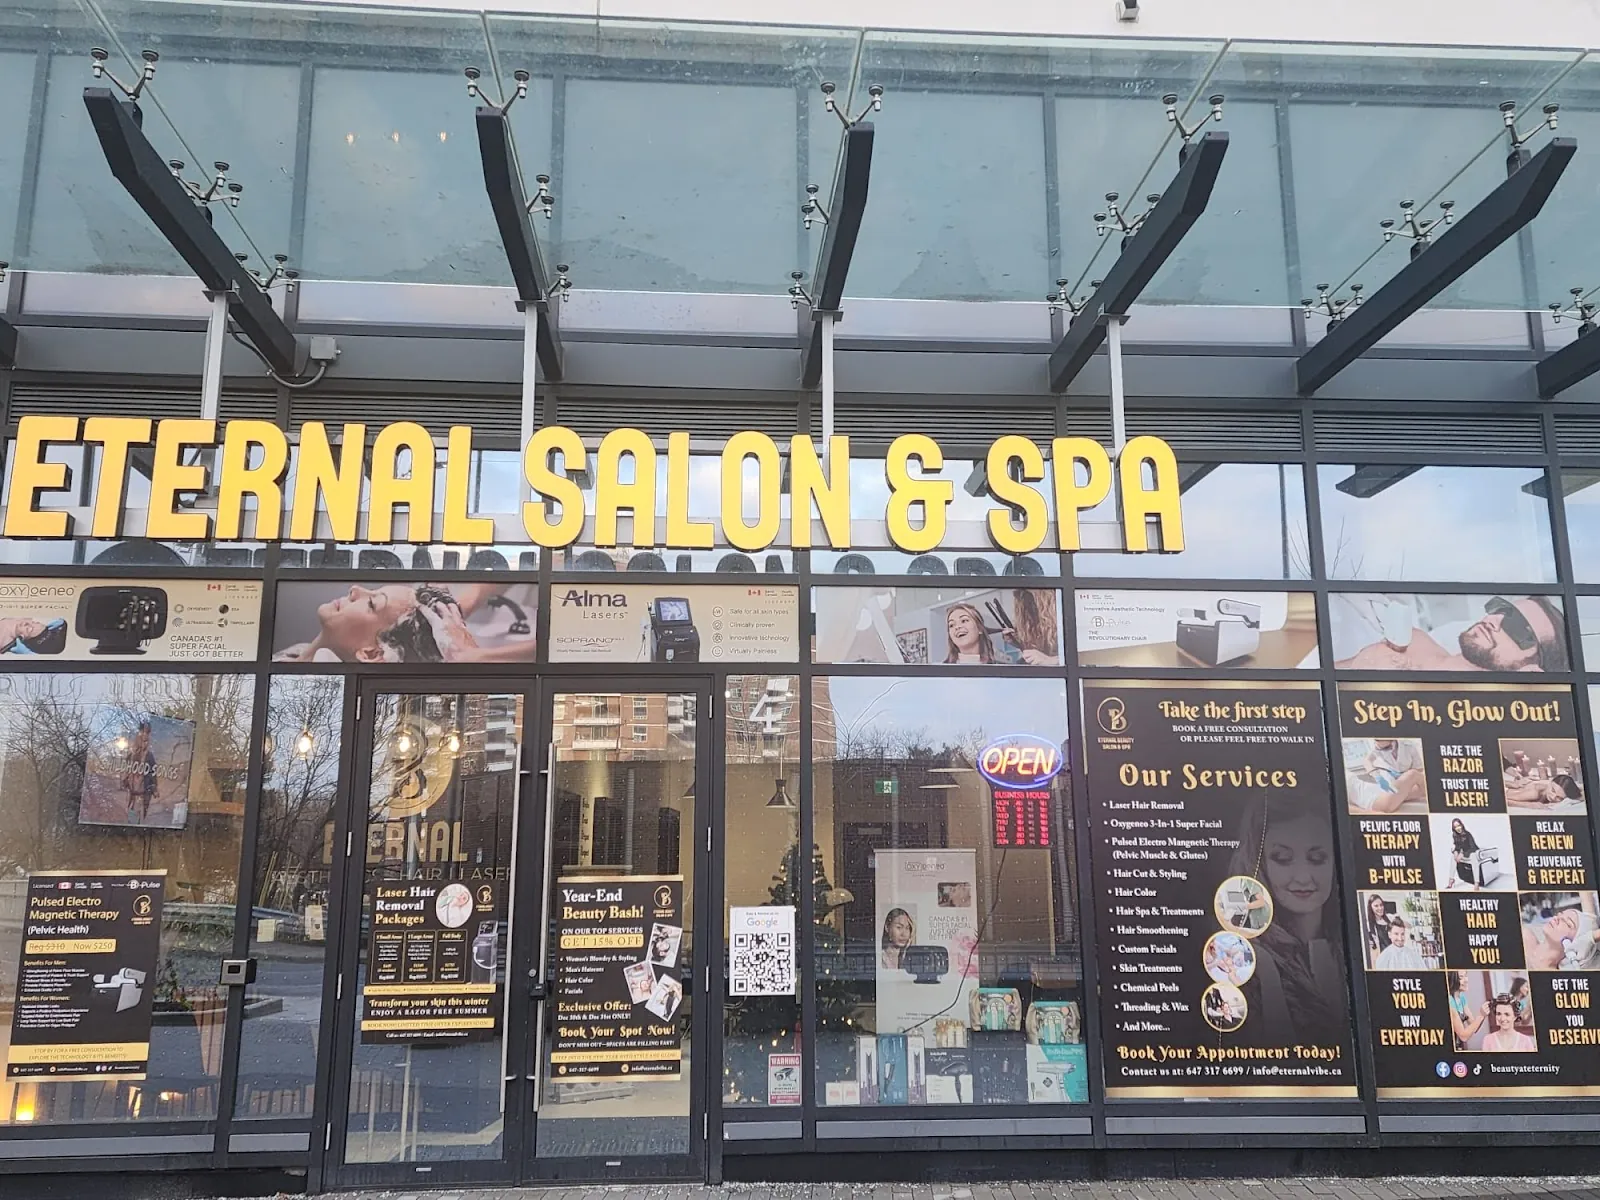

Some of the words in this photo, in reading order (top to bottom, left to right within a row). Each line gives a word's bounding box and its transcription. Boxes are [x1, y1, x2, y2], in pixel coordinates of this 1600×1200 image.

[4, 416, 495, 544] ETERNAL
[522, 426, 850, 551] SALON
[884, 434, 953, 555] &
[987, 435, 1185, 555] SPA
[560, 590, 627, 607] Alma
[583, 611, 624, 619] Lasers
[748, 693, 777, 732] 4
[1158, 701, 1200, 722] Take
[1204, 701, 1229, 718] the
[1231, 701, 1268, 722] first
[1272, 702, 1306, 723] step
[1354, 700, 1403, 727] Step
[1407, 700, 1442, 726] In,
[1448, 700, 1505, 727] Glow
[1511, 700, 1560, 722] Out!
[1194, 735, 1223, 743] PLEASE
[1440, 745, 1463, 756] RAZE
[1465, 746, 1482, 757] THE
[982, 747, 1055, 775] OPEN
[1443, 758, 1484, 773] RAZOR
[1119, 763, 1171, 787] Our
[1183, 764, 1297, 789] Services
[1441, 779, 1469, 790] TRUST
[1471, 779, 1489, 790] THE
[1446, 792, 1489, 807] LASER!
[1110, 801, 1130, 810] Laser
[1132, 801, 1150, 810] Hair
[1151, 801, 1184, 810] Removal
[1110, 820, 1148, 830] Oxygeneo
[1150, 820, 1175, 828] 3-In-1
[1176, 820, 1198, 830] Super
[1200, 820, 1222, 829] Facial
[1360, 821, 1390, 832] PELVIC
[1393, 821, 1421, 832] FLOOR
[1536, 822, 1565, 832] RELAX
[1112, 838, 1137, 846] Pulsed
[1139, 838, 1166, 847] Electro
[1168, 838, 1209, 848] Mangnetic
[1210, 838, 1240, 848] Therapy
[1364, 834, 1420, 849] THERAPY
[1531, 835, 1574, 850] RENEW
[1113, 851, 1138, 860] (Pelvic
[1140, 852, 1168, 860] Muscle
[1170, 852, 1178, 860] &
[1179, 852, 1208, 860] Glutes)
[1382, 855, 1405, 866] WITH
[1527, 856, 1582, 868] REJUVENATE
[1114, 869, 1131, 878] Hair
[1133, 870, 1148, 878] Cut
[1149, 870, 1157, 878] &
[1159, 870, 1187, 880] Styling
[1369, 869, 1423, 884] B-PULSE
[1528, 869, 1536, 884] &
[1541, 869, 1585, 884] REPEAT
[377, 888, 406, 898] Laser
[410, 887, 435, 897] Hair
[563, 888, 622, 903] Year-End
[1115, 888, 1133, 897] Hair
[1134, 888, 1157, 897] Color
[31, 897, 65, 907] Pulsed
[66, 896, 101, 905] Electro
[376, 900, 424, 911] Removal
[1459, 899, 1499, 911] HEALTHY
[29, 910, 76, 921] Magnetic
[79, 910, 119, 921] Therapy
[563, 907, 606, 923] Beauty
[609, 905, 644, 919] Bash!
[1116, 907, 1134, 916] Hair
[1136, 907, 1150, 918] Spa
[1151, 907, 1159, 916] &
[1161, 907, 1204, 916] Treatments
[375, 914, 424, 926] Packages
[746, 917, 778, 928] Google
[1466, 913, 1496, 929] HAIR
[27, 926, 55, 935] (Pelvic
[57, 926, 89, 934] Health)
[1117, 926, 1135, 934] Hair
[1136, 926, 1189, 936] Smoothening
[563, 937, 589, 947] GET
[592, 936, 613, 946] 15%
[617, 935, 642, 946] OFF
[1468, 934, 1498, 946] HAPPY
[93, 942, 113, 950] $250
[1118, 945, 1149, 953] Custom
[1150, 945, 1176, 953] Facials
[1470, 948, 1500, 964] YOU!
[1119, 964, 1138, 973] Skin
[1139, 964, 1182, 973] Treatments
[1121, 983, 1158, 992] Chemical
[1159, 984, 1179, 992] Peels
[1393, 979, 1421, 990] STYLE
[1552, 979, 1570, 990] GET
[1571, 979, 1588, 990] THE
[559, 1002, 601, 1011] Exclusive
[604, 1001, 631, 1011] Offer:
[1392, 993, 1426, 1009] YOUR
[1555, 993, 1590, 1009] GLOW
[1121, 1003, 1161, 1013] Threading
[1162, 1003, 1170, 1011] &
[1171, 1003, 1189, 1011] Wax
[1123, 1022, 1140, 1031] And
[1141, 1022, 1170, 1031] More...
[1401, 1015, 1420, 1027] WAY
[1566, 1015, 1584, 1027] YOU
[559, 1027, 586, 1038] Book
[590, 1026, 614, 1038] Your
[620, 1026, 642, 1037] Spot
[647, 1024, 675, 1035] Now!
[1380, 1029, 1444, 1046] EVERYDAY
[1117, 1046, 1157, 1062] Book
[1159, 1046, 1192, 1062] Your
[1197, 1046, 1288, 1062] Appointment
[1293, 1046, 1341, 1062] Today!
[771, 1057, 799, 1066] WARNING
[1121, 1066, 1157, 1076] Contact
[1160, 1068, 1169, 1076] us
[1172, 1067, 1183, 1076] at:
[1186, 1067, 1201, 1076] 647
[1204, 1067, 1219, 1076] 317
[1222, 1067, 1244, 1076] 6699
[1253, 1067, 1342, 1076] info@eternalvibe.ca
[1491, 1064, 1560, 1074] beautyateternity
